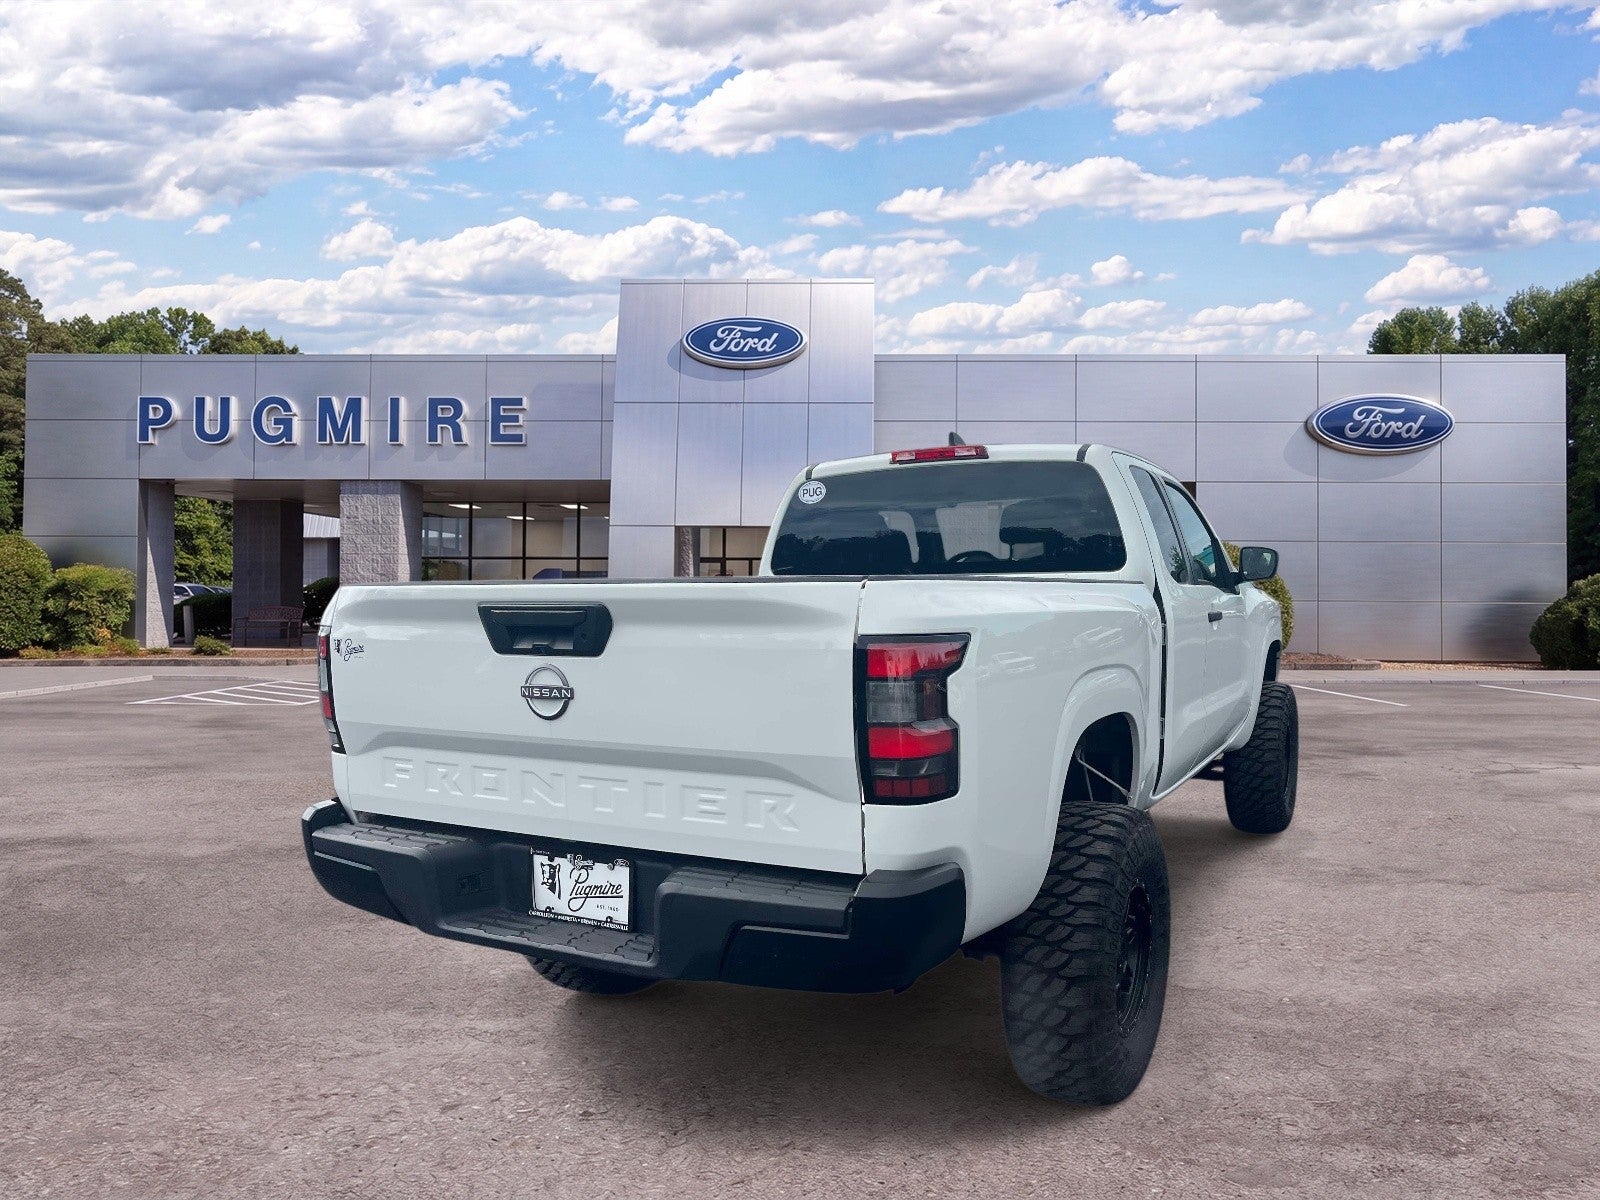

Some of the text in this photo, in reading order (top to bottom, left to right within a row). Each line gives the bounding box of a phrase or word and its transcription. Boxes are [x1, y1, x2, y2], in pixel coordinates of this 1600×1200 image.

[709, 325, 779, 352] Ford
[137, 395, 528, 445] PUGMIRE
[1344, 405, 1426, 439] Ford
[802, 487, 822, 498] PUG
[521, 687, 571, 697] NISSAN
[382, 756, 800, 831] FRONTIER
[568, 867, 623, 912] Pugmire
